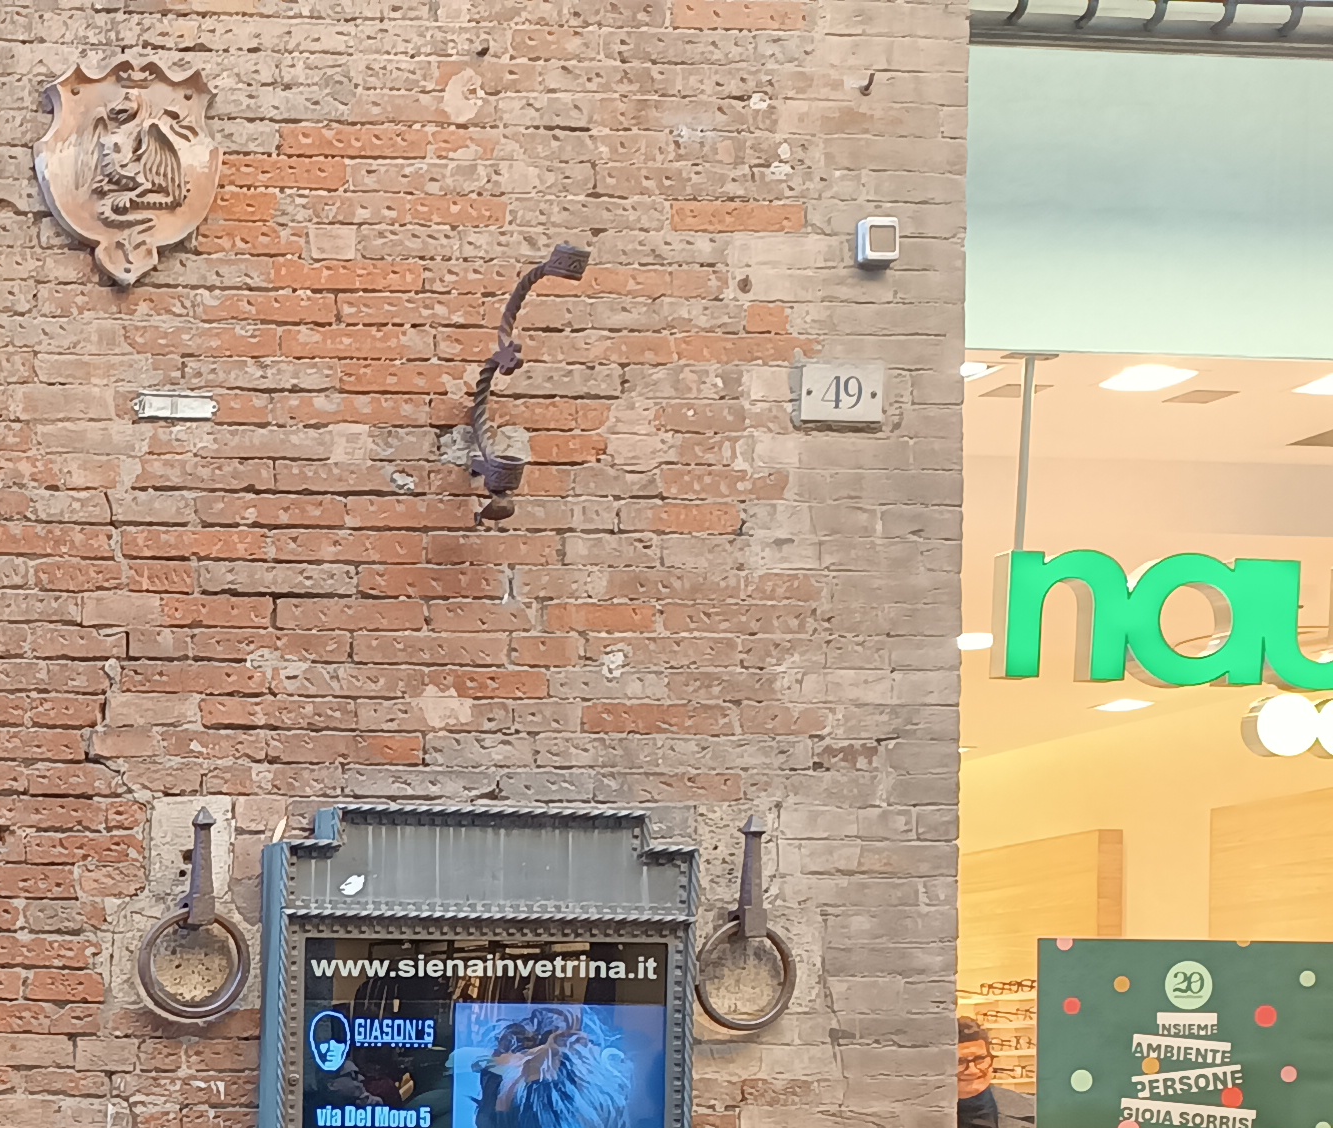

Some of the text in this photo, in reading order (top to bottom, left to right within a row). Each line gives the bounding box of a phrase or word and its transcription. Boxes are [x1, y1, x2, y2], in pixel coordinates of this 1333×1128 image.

[821, 375, 863, 410] 49
[310, 953, 658, 979] www.sienainvetrina.it
[1172, 971, 1205, 995] 20
[354, 1018, 434, 1041] GIASON'S
[1132, 1041, 1232, 1064] AMBIENTE
[1135, 1069, 1244, 1098] PERSONE
[316, 1105, 431, 1128] via Del Moro 5
[1120, 1106, 1175, 1125] GIOIA
